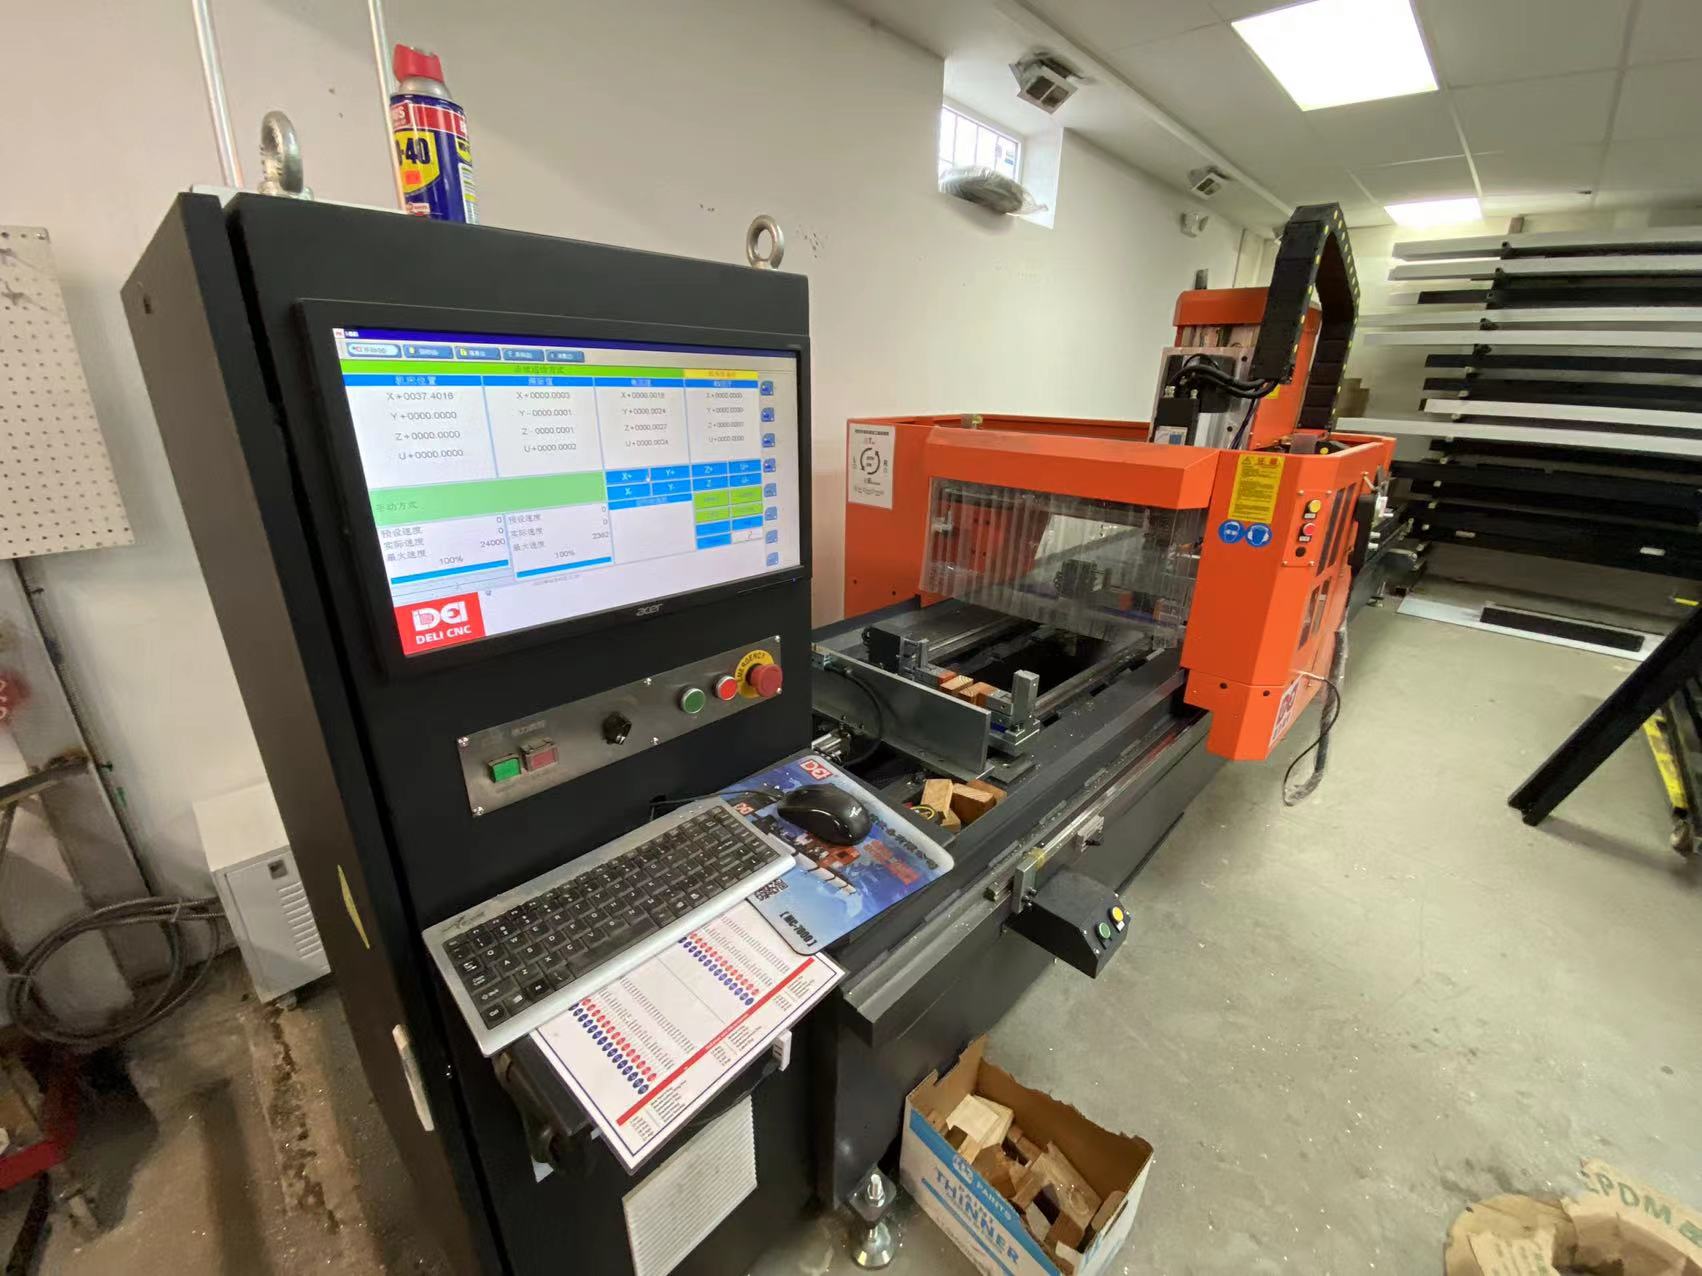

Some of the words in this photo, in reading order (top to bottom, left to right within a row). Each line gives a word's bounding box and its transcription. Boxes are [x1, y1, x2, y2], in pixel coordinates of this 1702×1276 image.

[439, 555, 464, 565] 100%
[554, 549, 576, 559] 100%
[415, 630, 444, 645] DELI
[446, 624, 472, 638] CNC
[936, 1167, 1020, 1265] THINNER
